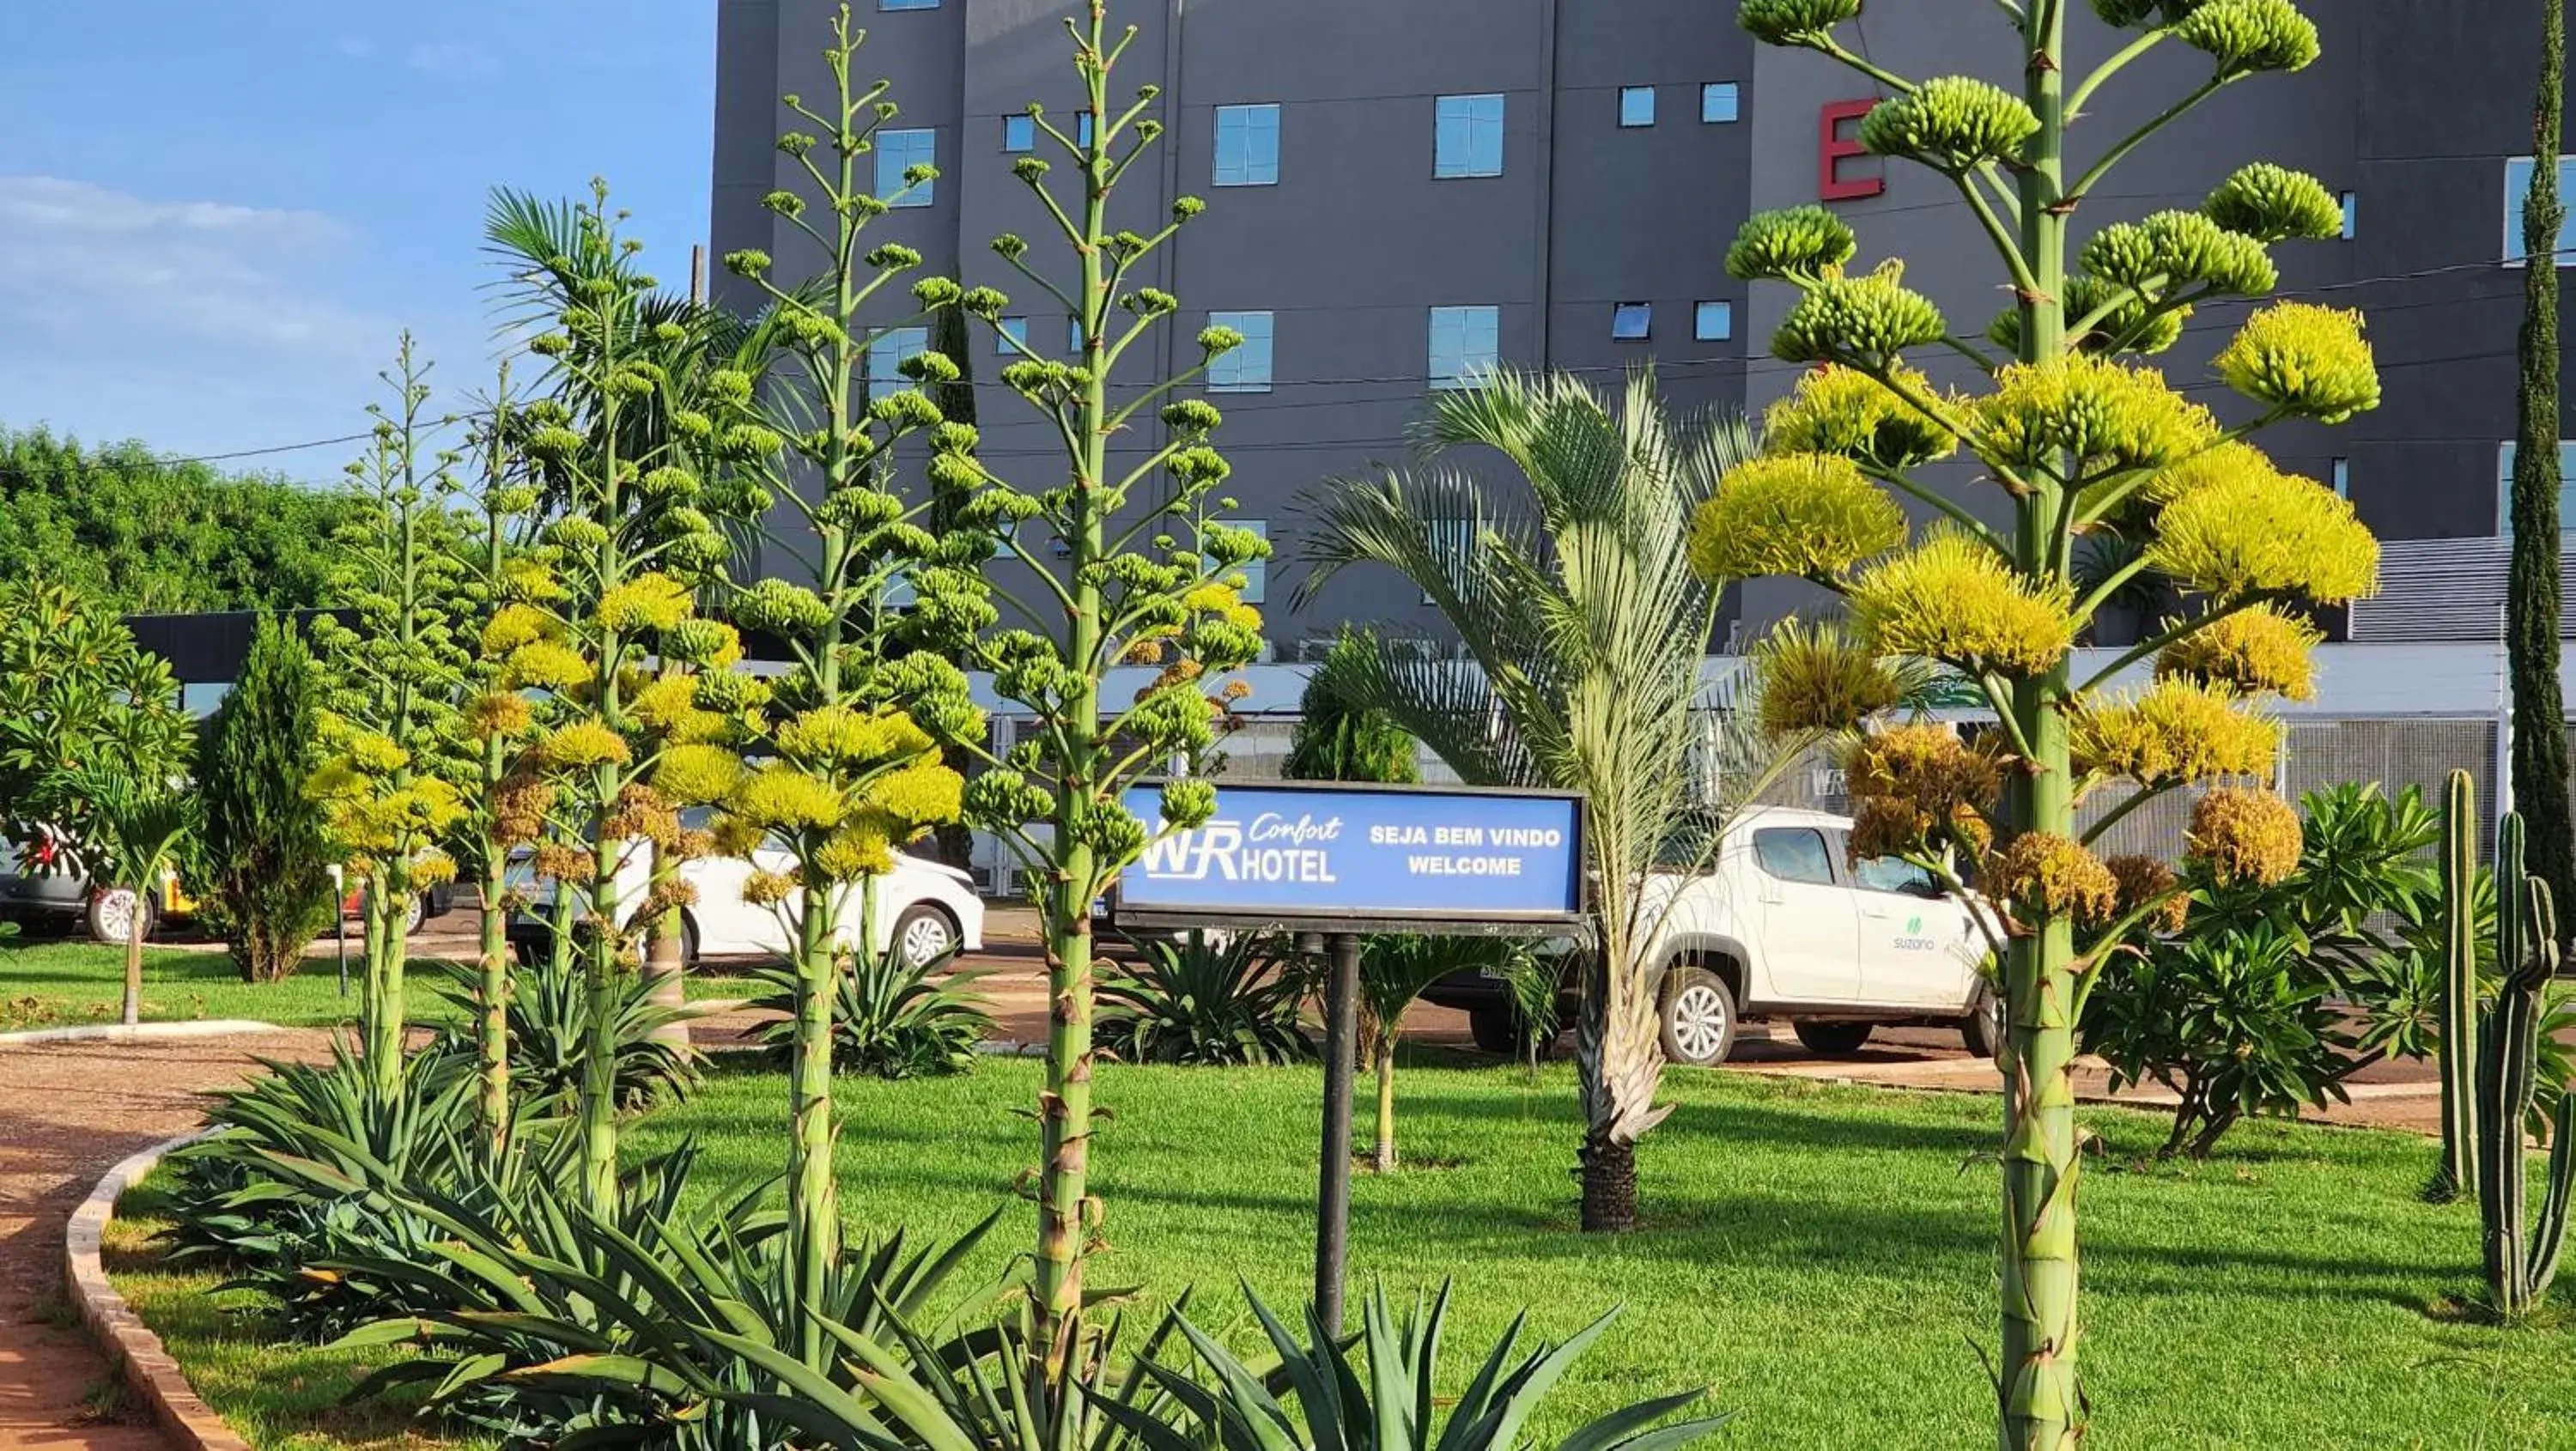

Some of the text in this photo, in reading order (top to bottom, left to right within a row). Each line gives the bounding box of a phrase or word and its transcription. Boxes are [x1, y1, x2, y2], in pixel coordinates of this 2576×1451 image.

[1249, 812, 1343, 847] Confort
[1370, 825, 1561, 847] SEJA BEM VINDO
[1141, 820, 1336, 883] WR HOTEL
[1408, 855, 1522, 875] WELCOME
